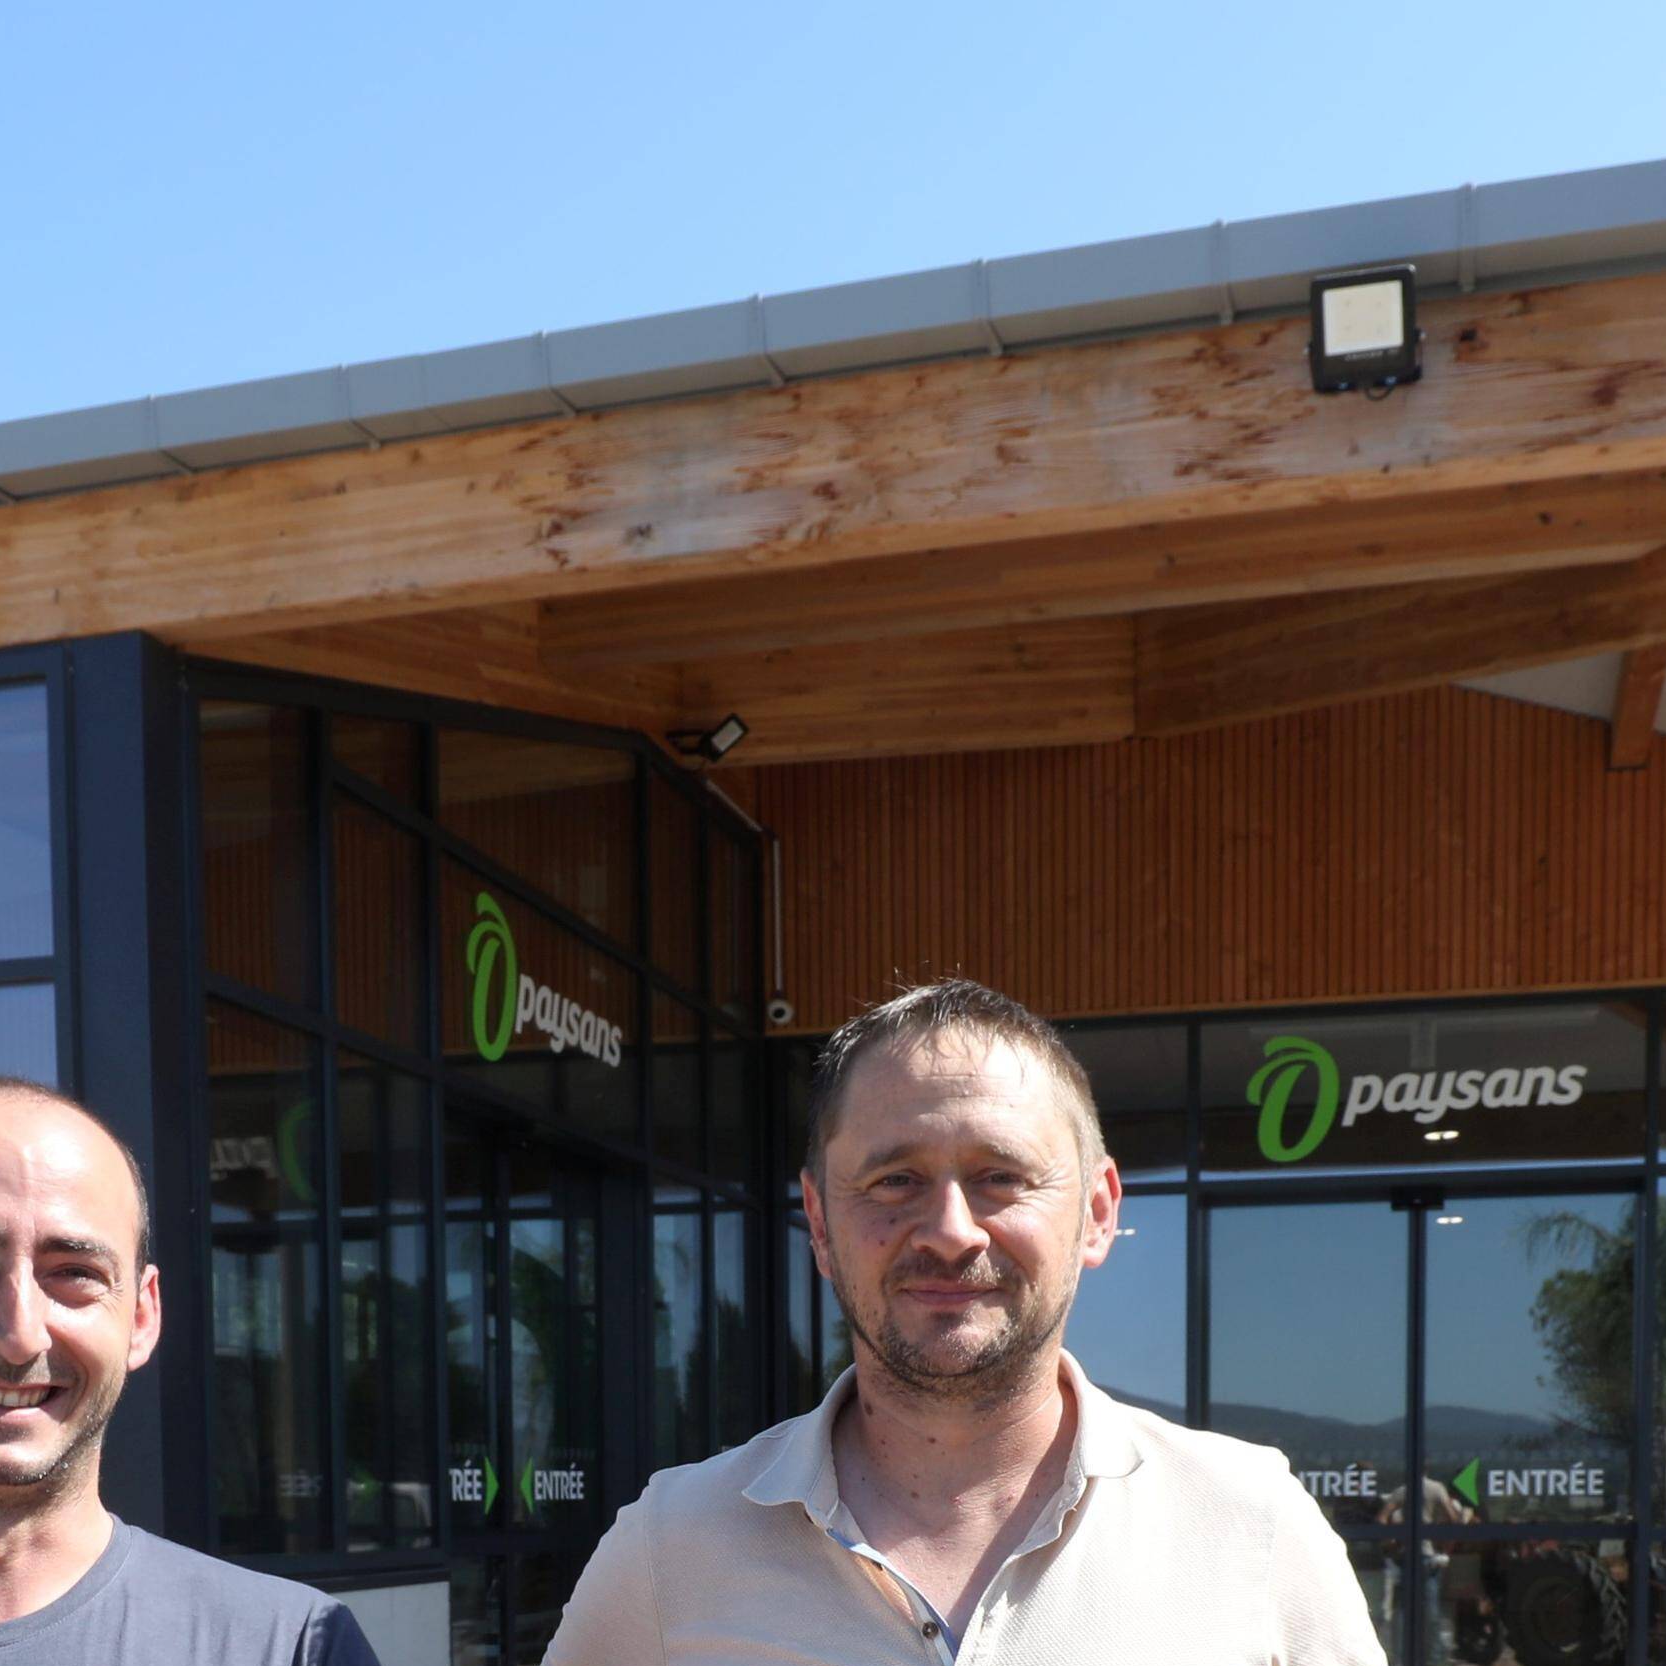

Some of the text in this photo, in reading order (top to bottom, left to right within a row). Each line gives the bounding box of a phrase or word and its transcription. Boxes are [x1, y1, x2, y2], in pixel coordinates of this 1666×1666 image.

[515, 973, 622, 1067] paysans
[1341, 1064, 1588, 1127] paysans
[449, 1459, 482, 1501] RÉE
[534, 1462, 585, 1501] ENTRÉE
[1296, 1464, 1377, 1497] TRÉE
[1487, 1462, 1604, 1496] ENTRÉE
